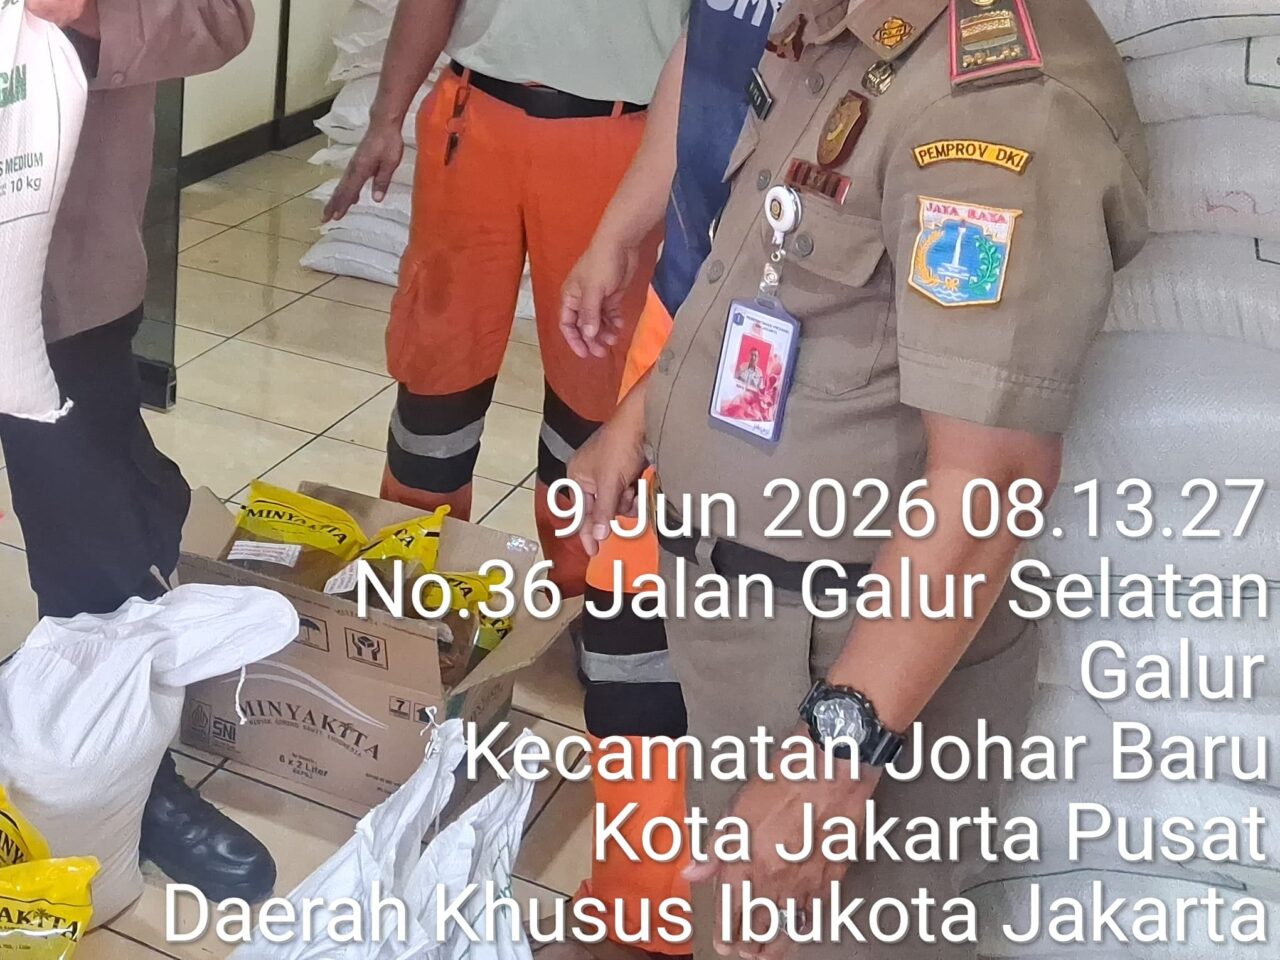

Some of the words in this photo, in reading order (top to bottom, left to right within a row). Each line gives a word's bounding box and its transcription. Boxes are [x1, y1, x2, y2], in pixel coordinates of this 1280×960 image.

[5, 152, 43, 175] MEDIUM
[918, 142, 988, 163] PEMPROV
[995, 150, 1024, 167] DKI
[10, 177, 23, 192] 10
[26, 175, 42, 191] kg
[926, 202, 960, 216] JAYA
[967, 208, 1008, 224] RAYA
[213, 720, 236, 741] SNI
[239, 699, 380, 761] MINYAKITA
[296, 760, 303, 769] 2
[305, 762, 328, 777] Liter
